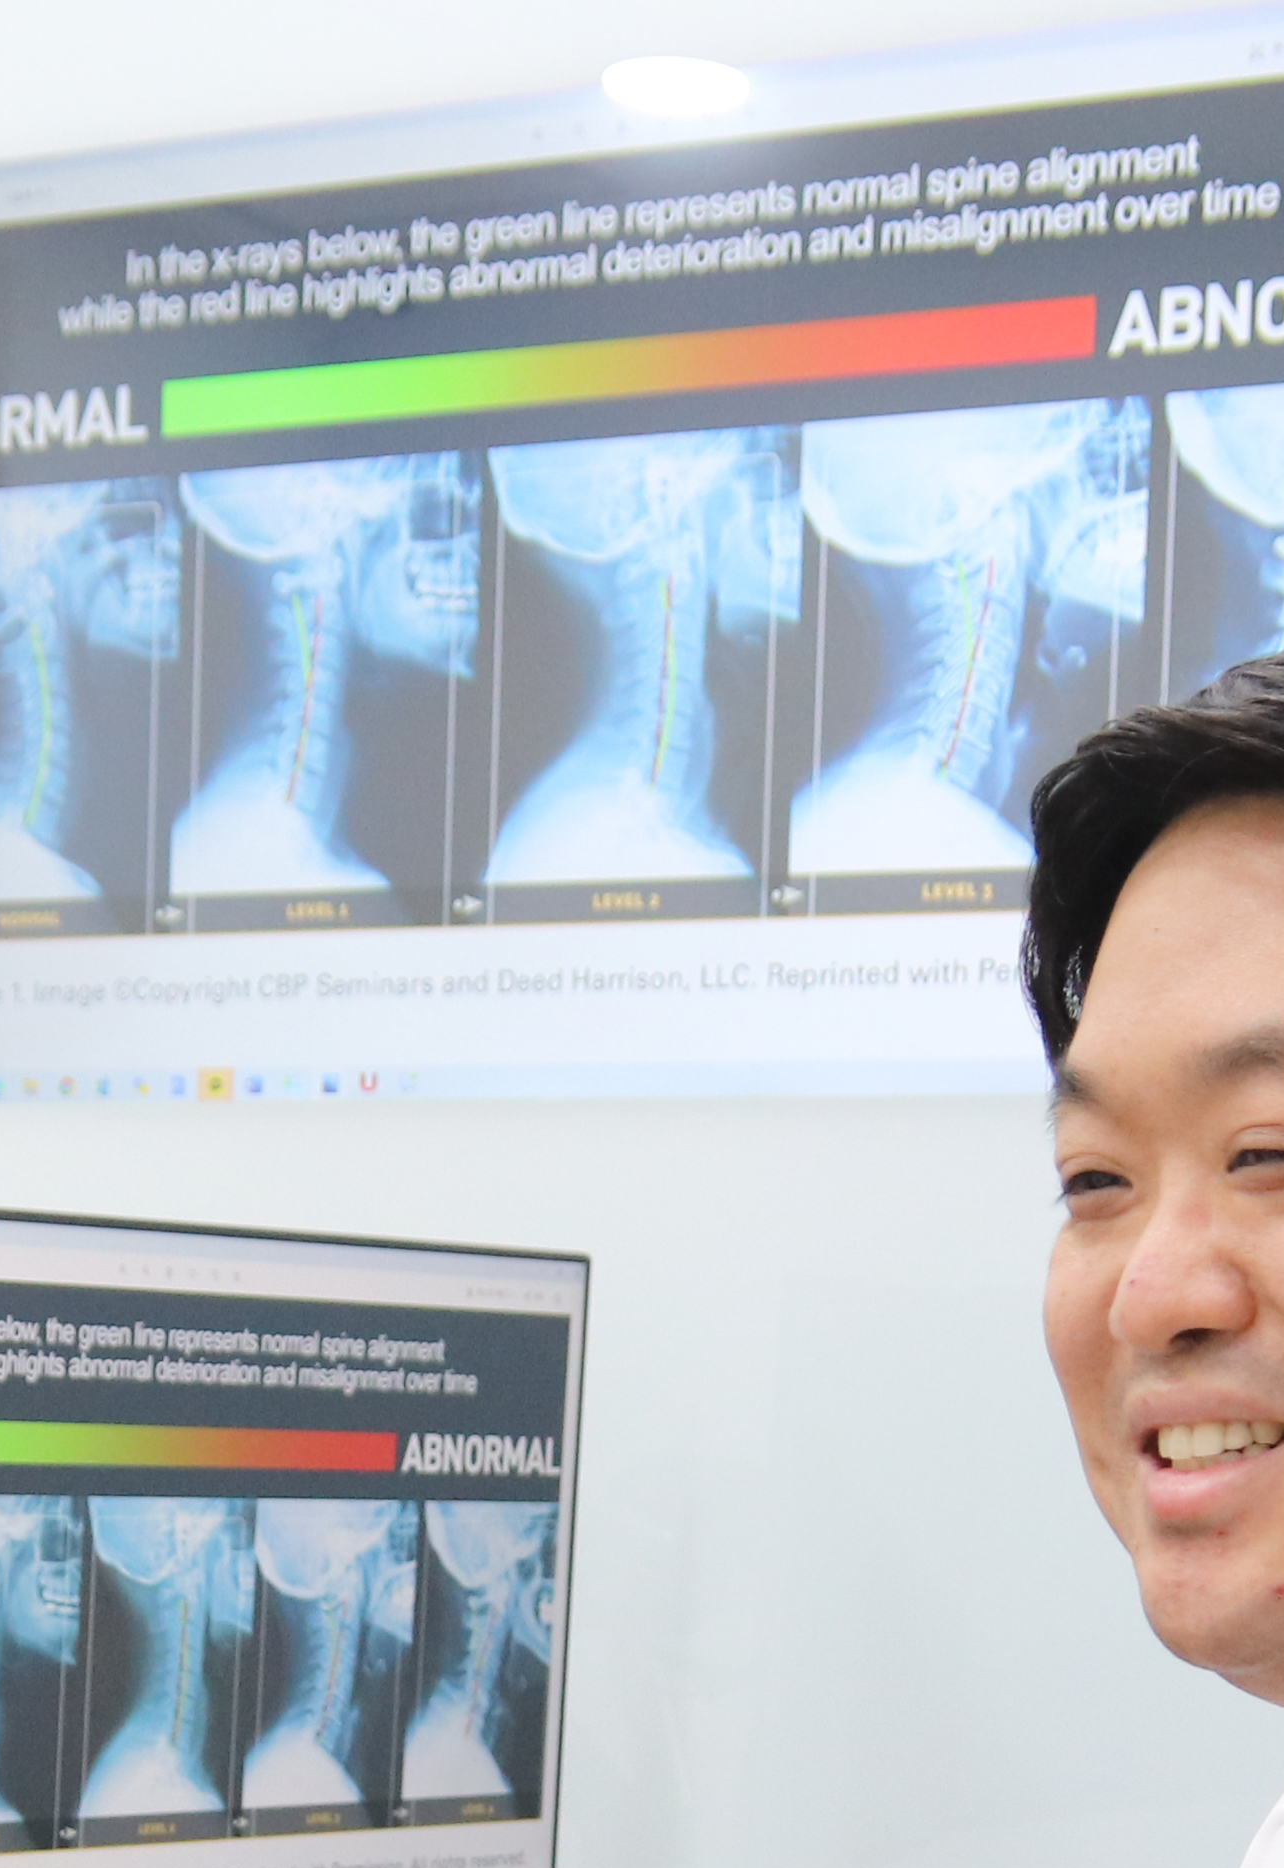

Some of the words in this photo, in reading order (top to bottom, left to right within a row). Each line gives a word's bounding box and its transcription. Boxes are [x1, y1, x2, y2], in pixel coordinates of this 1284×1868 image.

[126, 248, 155, 286] In
[159, 243, 207, 281] the
[211, 234, 302, 279] x-rays
[308, 228, 404, 264] below,
[410, 218, 460, 256] the
[466, 215, 557, 261] green
[562, 201, 620, 238] line
[625, 179, 796, 236] represents
[803, 163, 919, 216] normal
[926, 157, 1021, 205] spine
[1026, 135, 1201, 197] alignment
[58, 295, 134, 335] while
[139, 290, 185, 327] the
[189, 281, 243, 324] red
[247, 278, 298, 313] line
[303, 265, 443, 319] highlights
[450, 247, 598, 296] abnormal
[603, 225, 802, 281] deterioration
[809, 215, 874, 260] and
[881, 193, 1110, 253] misalignment
[1115, 190, 1194, 231] over
[1202, 176, 1283, 222] time
[285, 901, 335, 921] LEVEL
[591, 891, 644, 911] LEVEL
[921, 881, 976, 902] LEVEL
[33, 980, 106, 1009] Image
[257, 973, 309, 997] CBP
[317, 971, 434, 997] Seminars
[442, 968, 488, 993] and
[498, 966, 564, 993] Deed
[572, 964, 690, 995] Harrison,
[700, 963, 756, 989] LLC.
[767, 961, 899, 993] Reprinted
[909, 960, 968, 985] with
[46, 1317, 75, 1345] the
[78, 1323, 132, 1351] green
[134, 1321, 166, 1349] line
[168, 1329, 259, 1357] represents
[261, 1331, 320, 1356] normal
[322, 1332, 365, 1362] spine
[368, 1334, 445, 1367] alignment
[68, 1352, 154, 1381] abnormal
[156, 1355, 260, 1385] deterioration
[263, 1363, 297, 1387] and
[299, 1364, 405, 1396] misalignment
[406, 1370, 441, 1393] over
[444, 1368, 478, 1395] time
[401, 1432, 561, 1475] ABNORMAL
